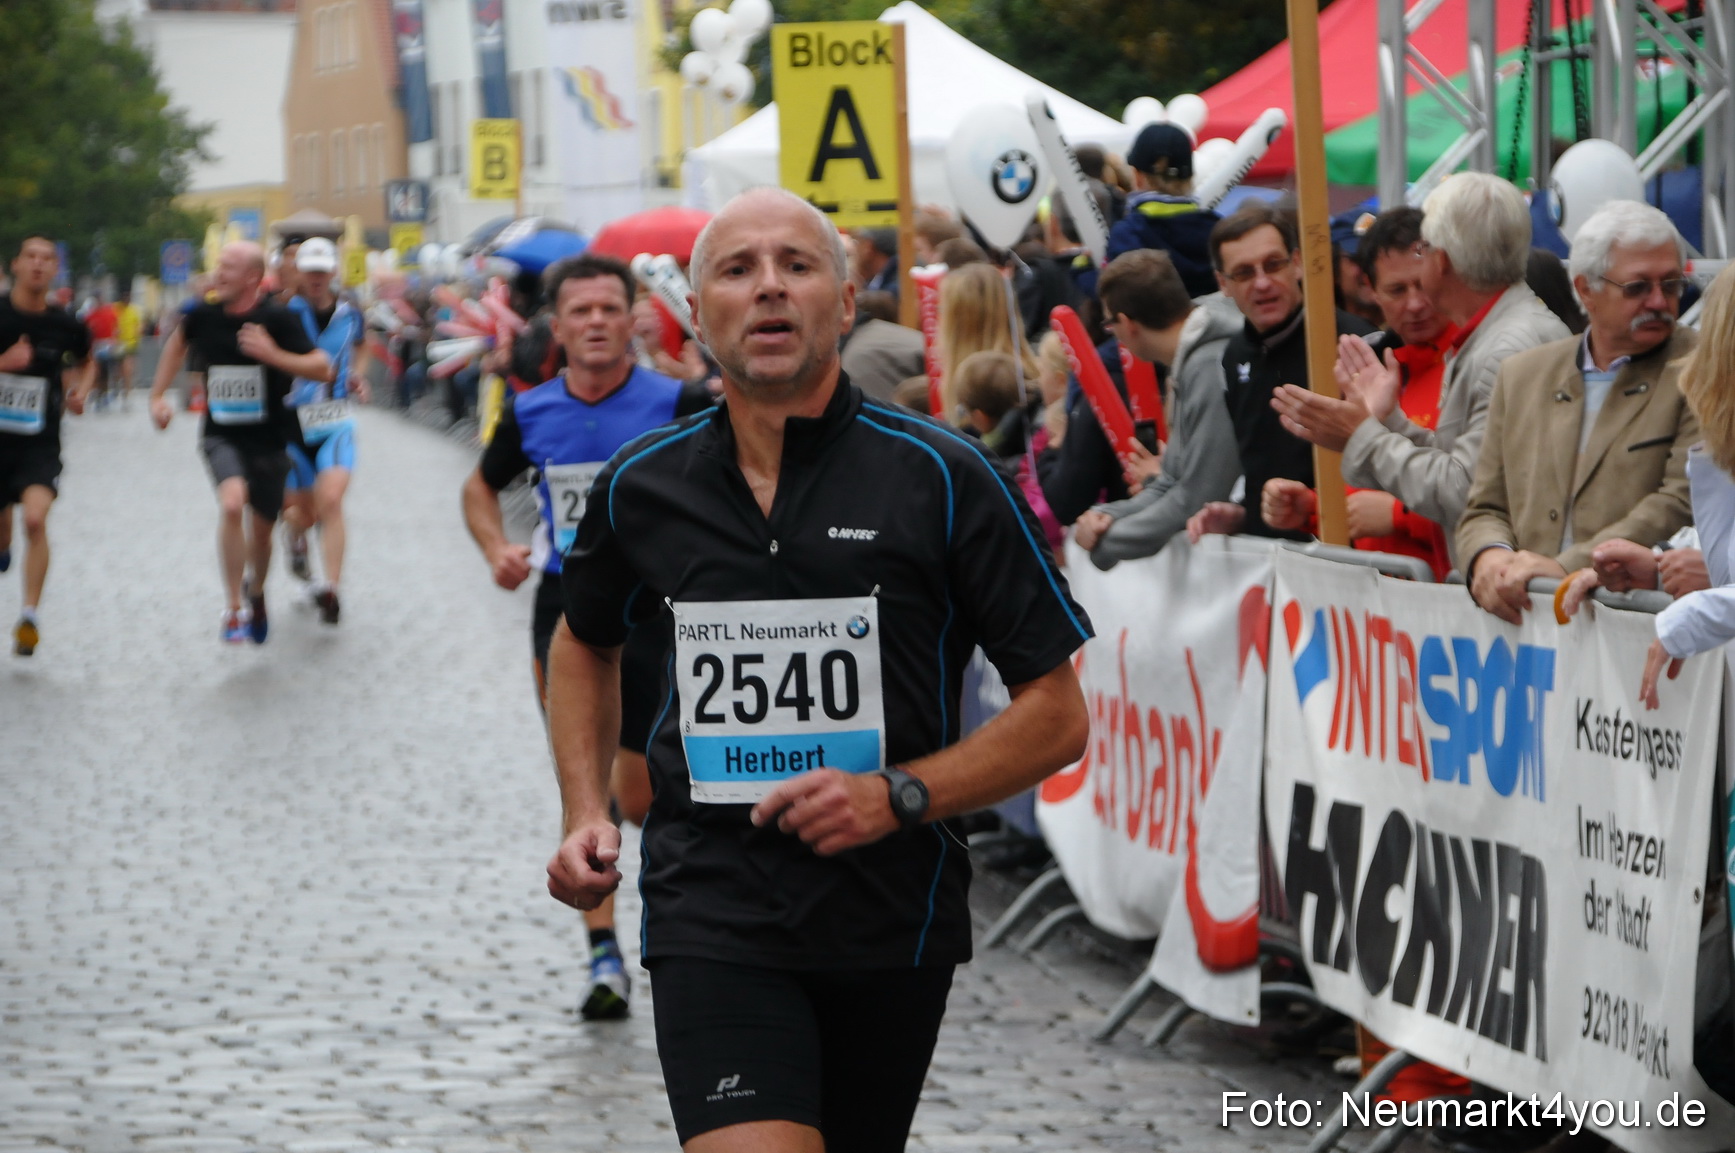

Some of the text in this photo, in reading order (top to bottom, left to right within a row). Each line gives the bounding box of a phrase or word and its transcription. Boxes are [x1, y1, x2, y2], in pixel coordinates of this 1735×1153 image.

[788, 31, 895, 68] Block
[807, 84, 882, 182] A
[484, 143, 507, 181] B
[562, 488, 592, 522] 2
[678, 621, 838, 641] PARTL Neumarkt
[692, 649, 860, 725] 2540
[725, 744, 826, 774] Herbert
[1578, 804, 1604, 861] Im
[1584, 878, 1612, 936] der
[1582, 984, 1629, 1052] 92318
